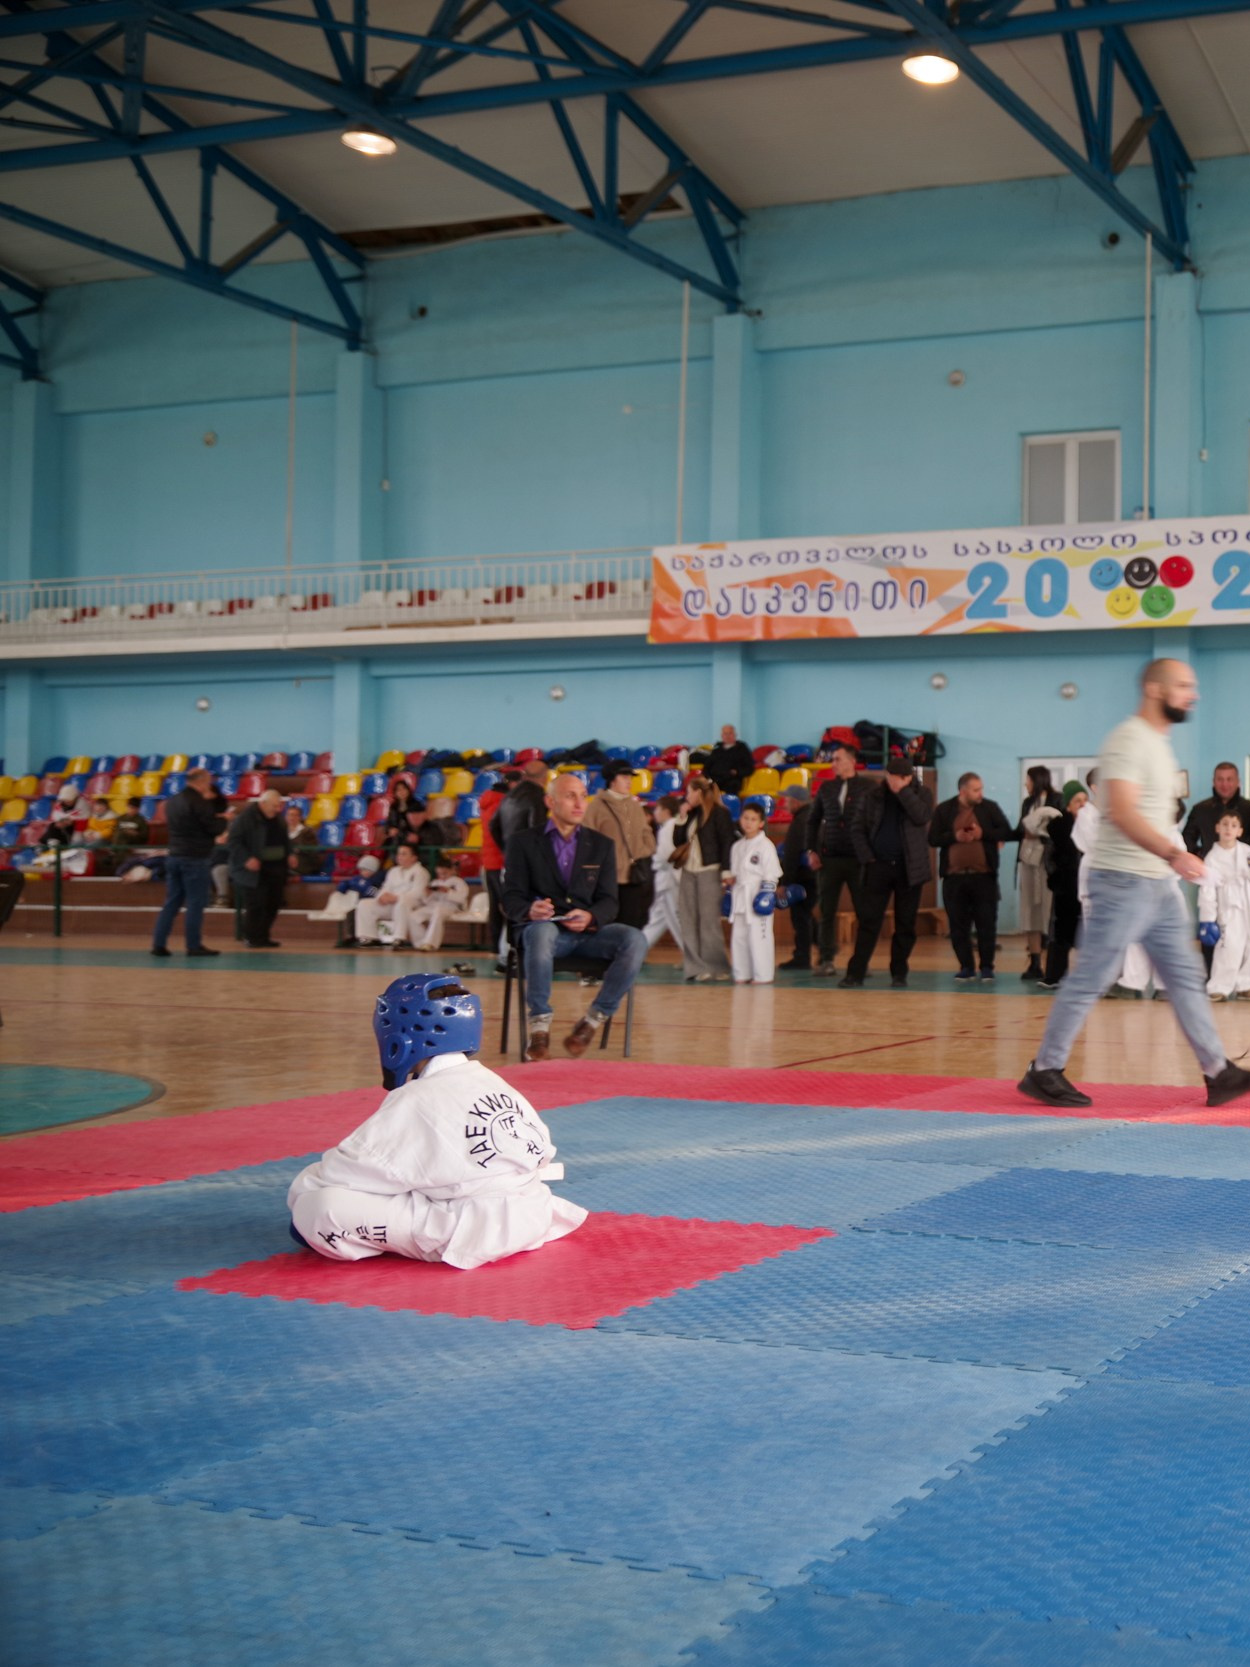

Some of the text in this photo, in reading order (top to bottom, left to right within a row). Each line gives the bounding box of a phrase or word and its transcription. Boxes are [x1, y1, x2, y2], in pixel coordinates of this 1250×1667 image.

[671, 542, 929, 572] საქართველოს
[953, 530, 1139, 557] სასკოლო
[682, 577, 929, 620] დასკვნითი
[498, 1115, 516, 1131] ITF
[372, 1225, 388, 1244] ITF
